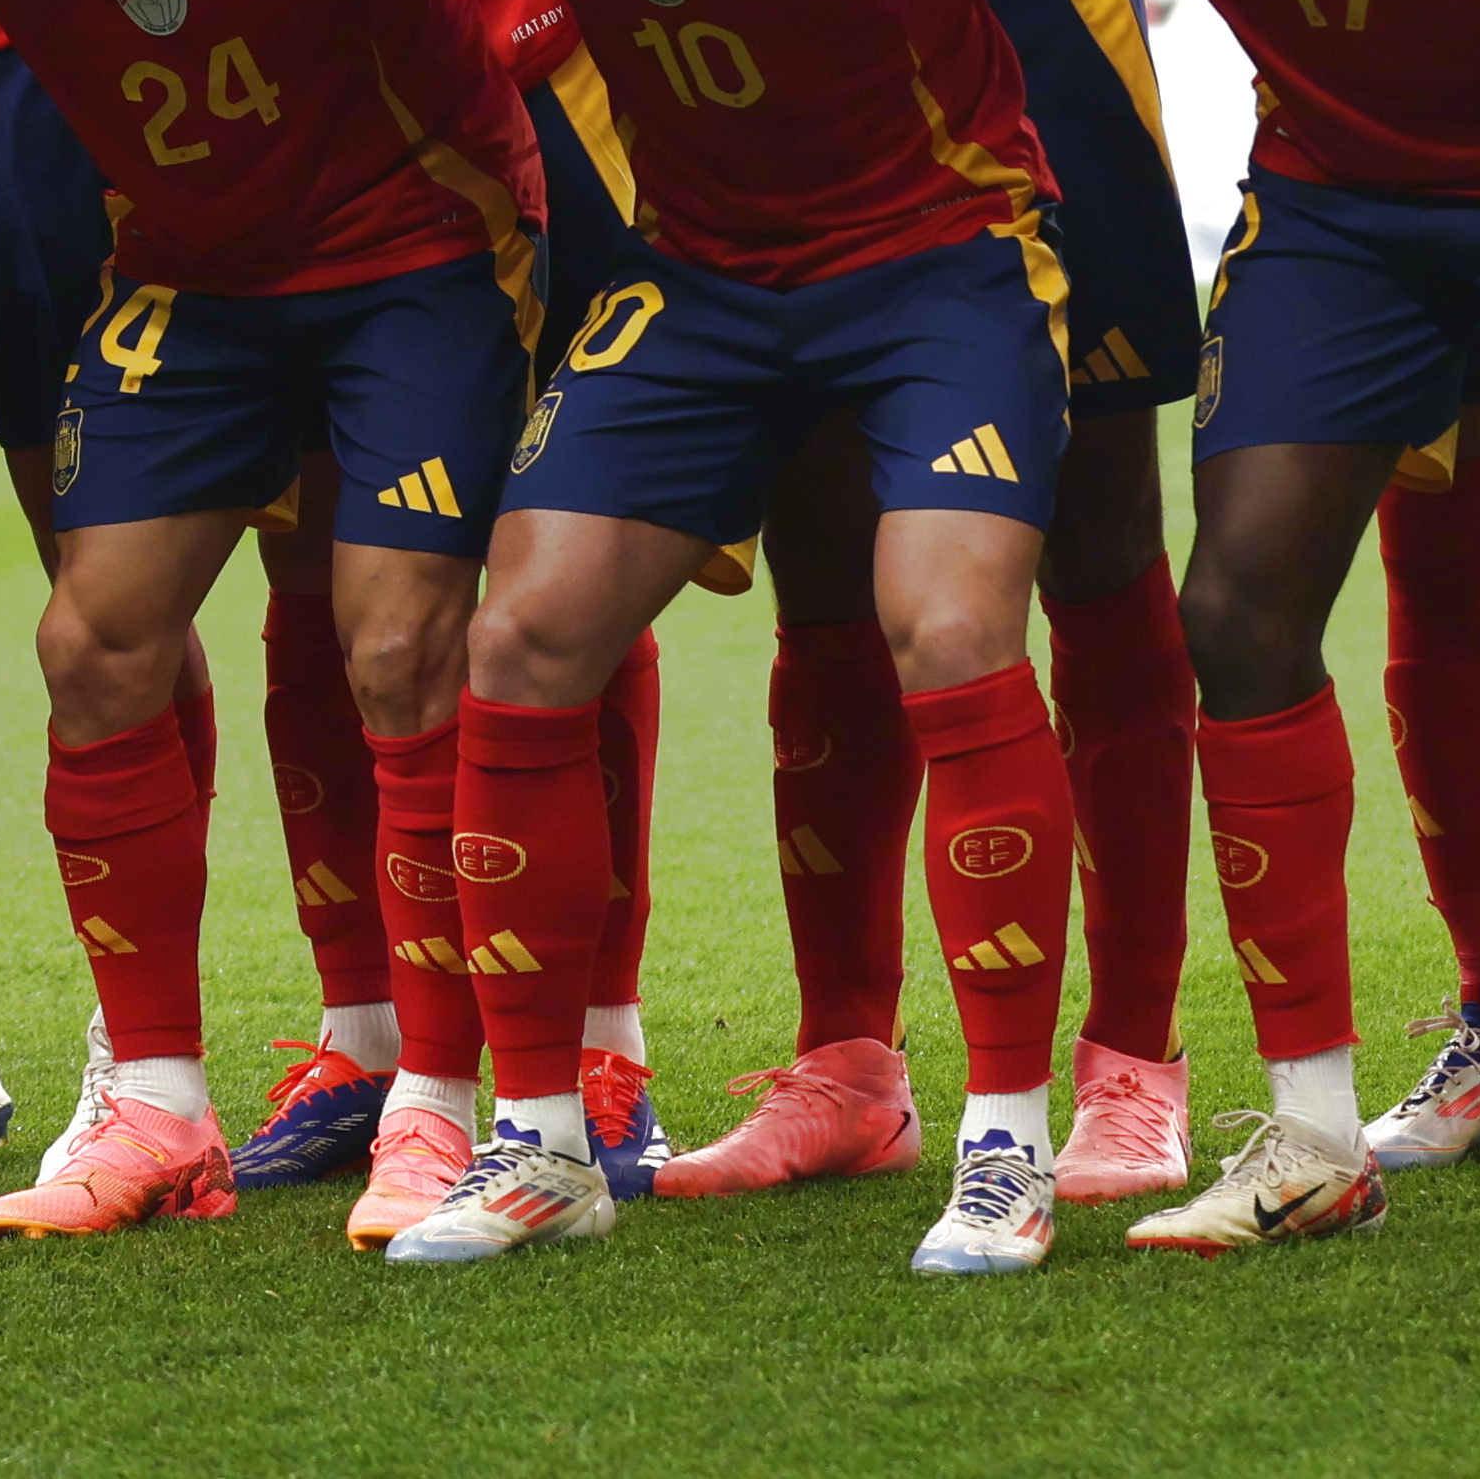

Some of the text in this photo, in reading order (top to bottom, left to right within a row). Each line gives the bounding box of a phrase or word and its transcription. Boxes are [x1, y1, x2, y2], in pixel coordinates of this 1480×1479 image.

[510, 5, 564, 44] HEAT.RDY
[632, 18, 766, 109] 10
[120, 37, 281, 167] 24
[460, 841, 503, 857] RF
[963, 836, 1009, 852] RF
[462, 857, 504, 872] EF
[965, 851, 1010, 868] EF
[531, 1171, 592, 1198] F50
